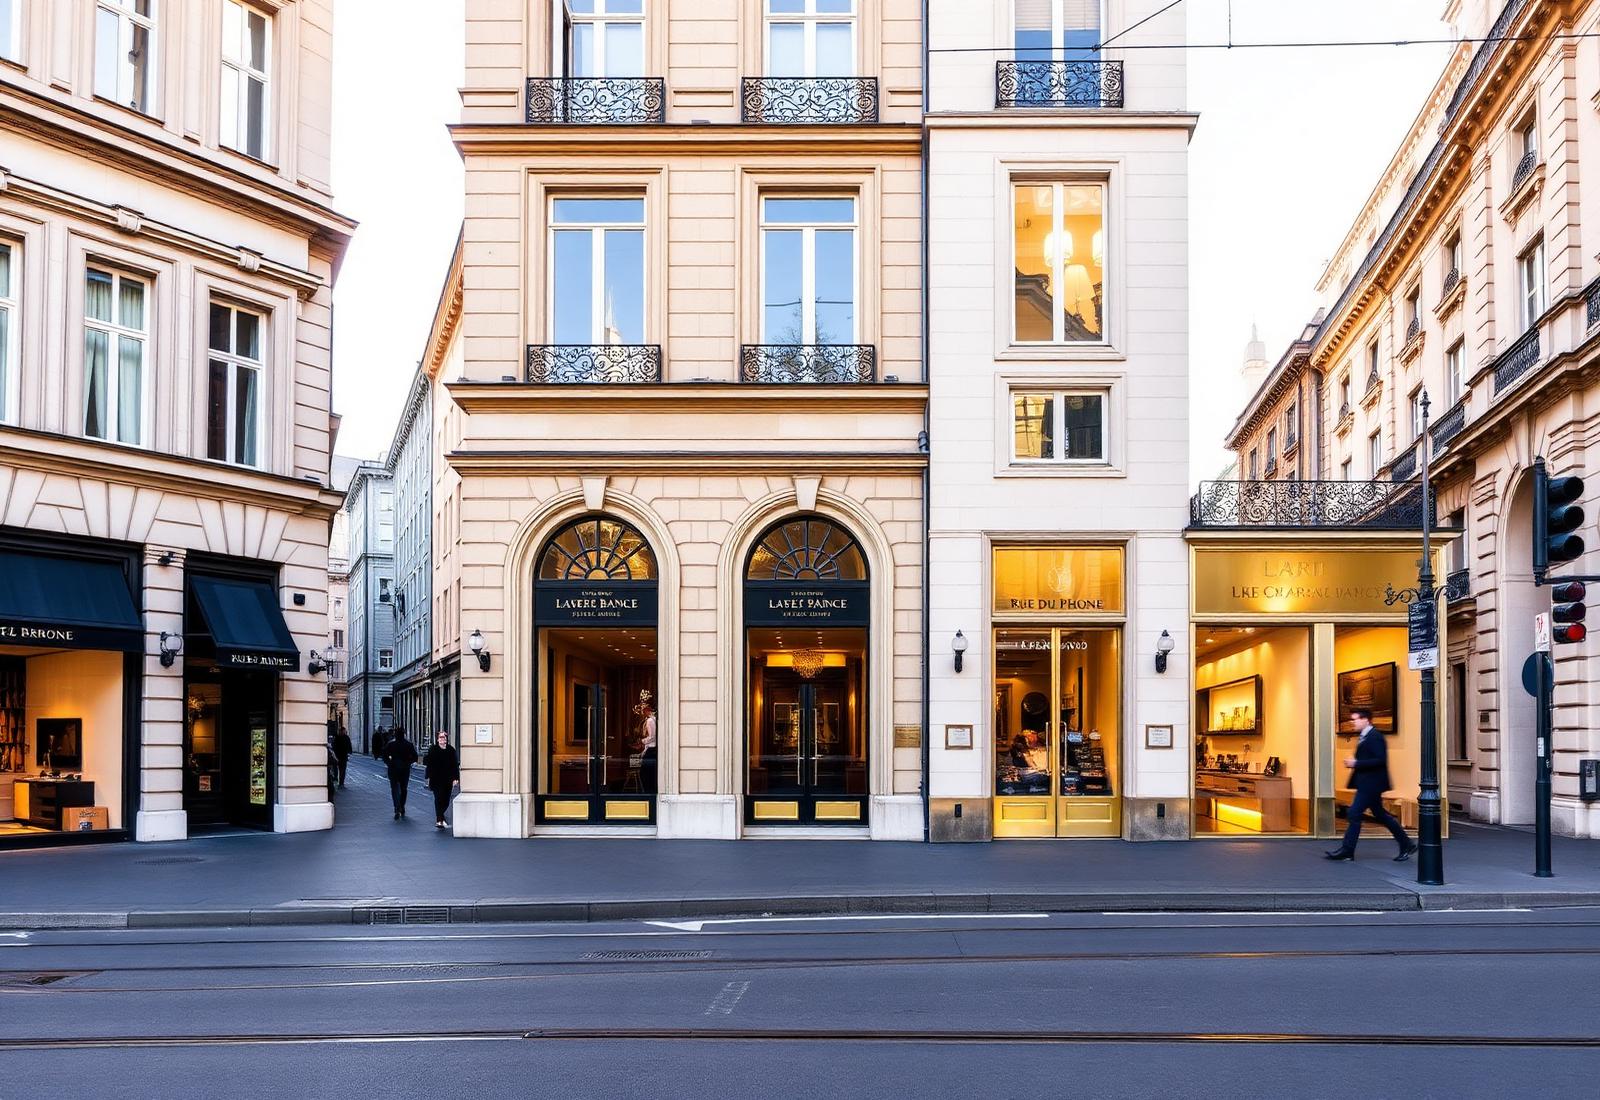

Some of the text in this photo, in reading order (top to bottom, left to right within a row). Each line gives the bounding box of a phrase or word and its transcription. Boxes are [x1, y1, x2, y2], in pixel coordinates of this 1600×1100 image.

[1010, 599, 1104, 609] RUE DU PHONE
